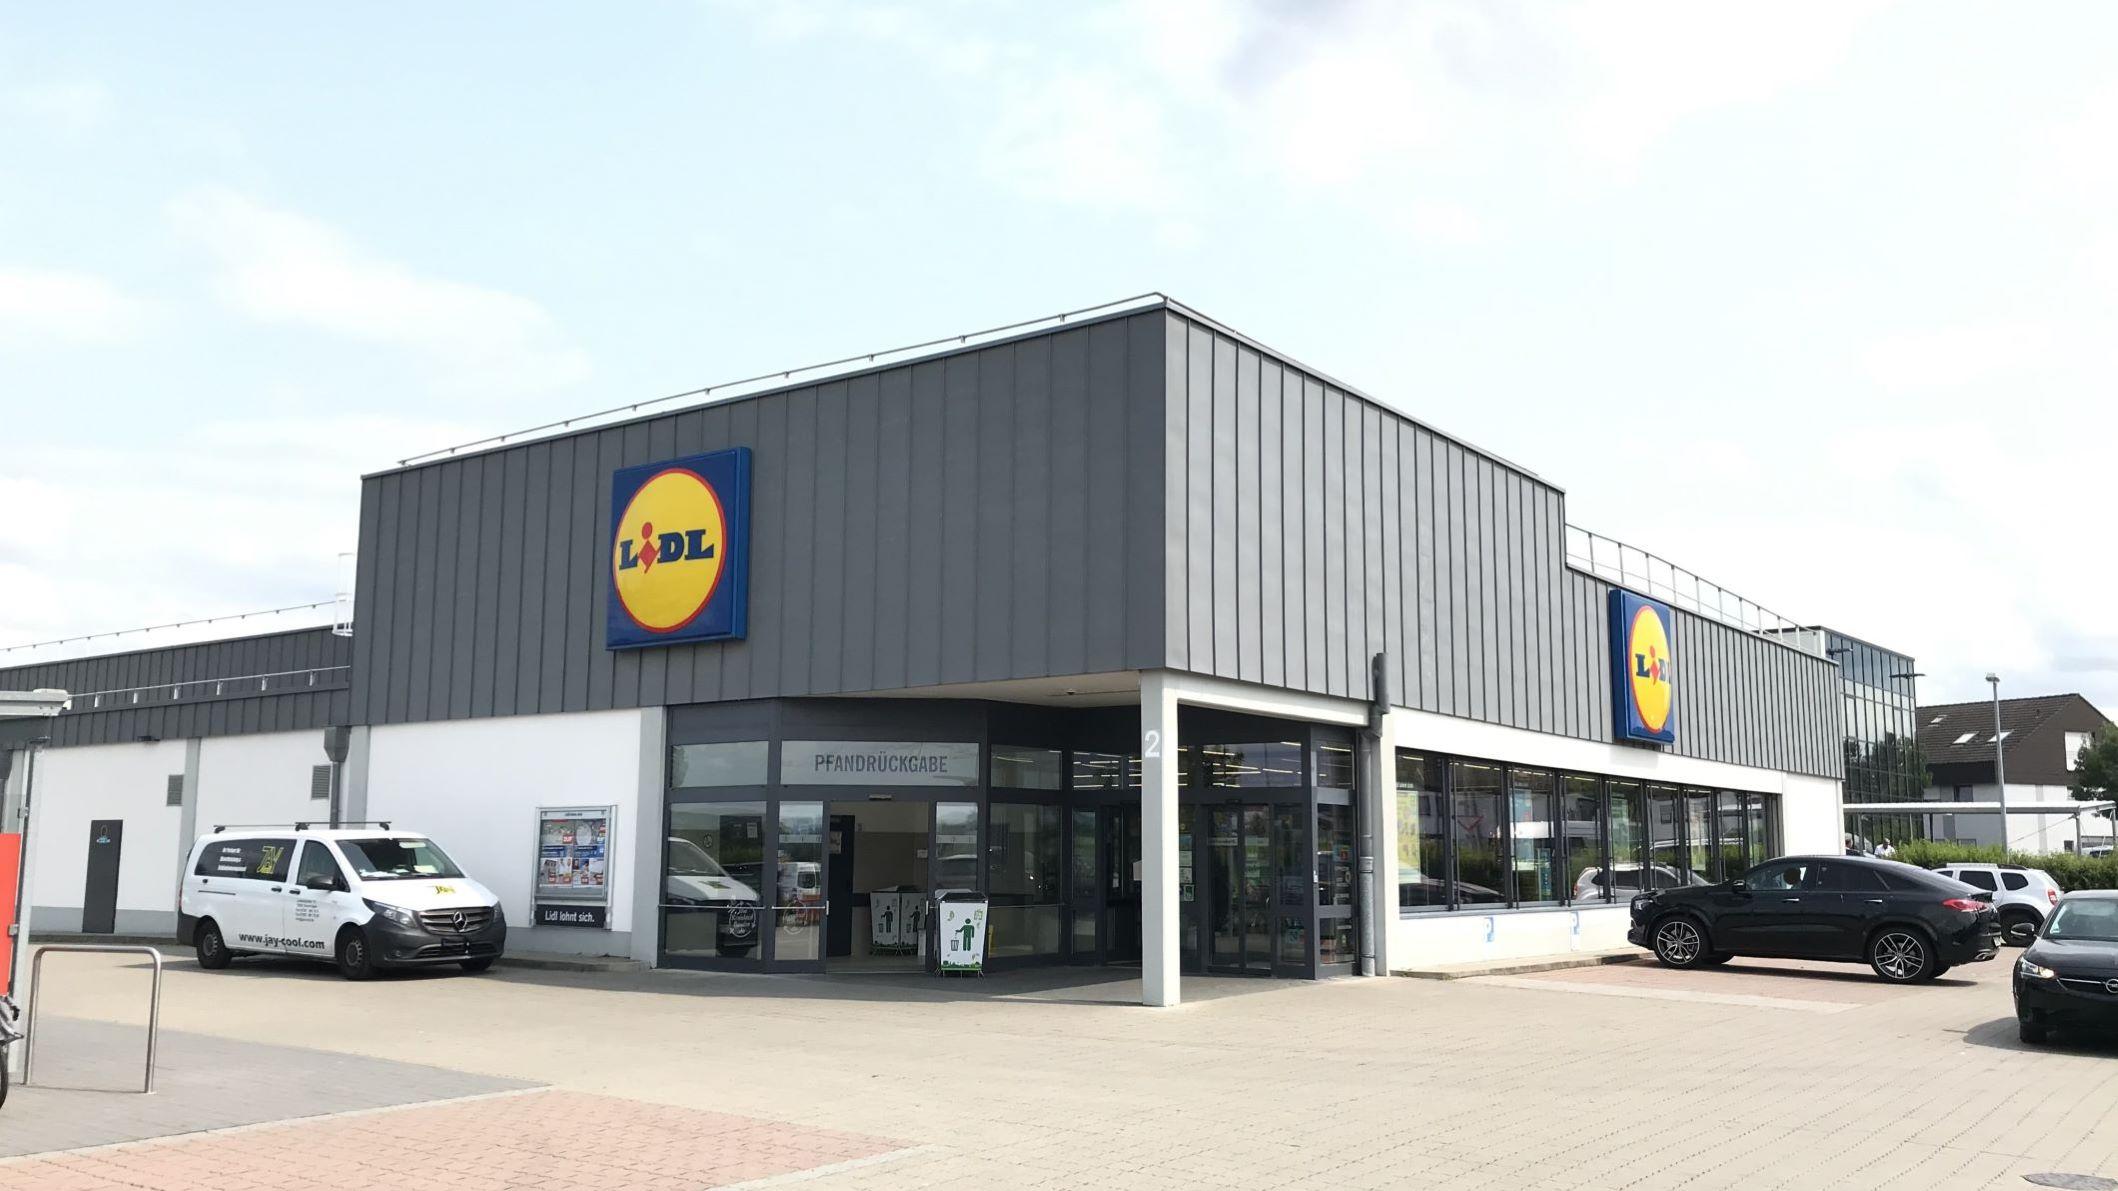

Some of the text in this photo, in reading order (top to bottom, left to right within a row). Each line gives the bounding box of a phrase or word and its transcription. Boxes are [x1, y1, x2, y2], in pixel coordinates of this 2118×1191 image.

[1144, 730, 1160, 758] 2
[814, 751, 948, 773] PFANDRÜCKGABE
[544, 910, 595, 923] Lidl lohnt sich.
[238, 933, 325, 949] www.jay-cool.com
